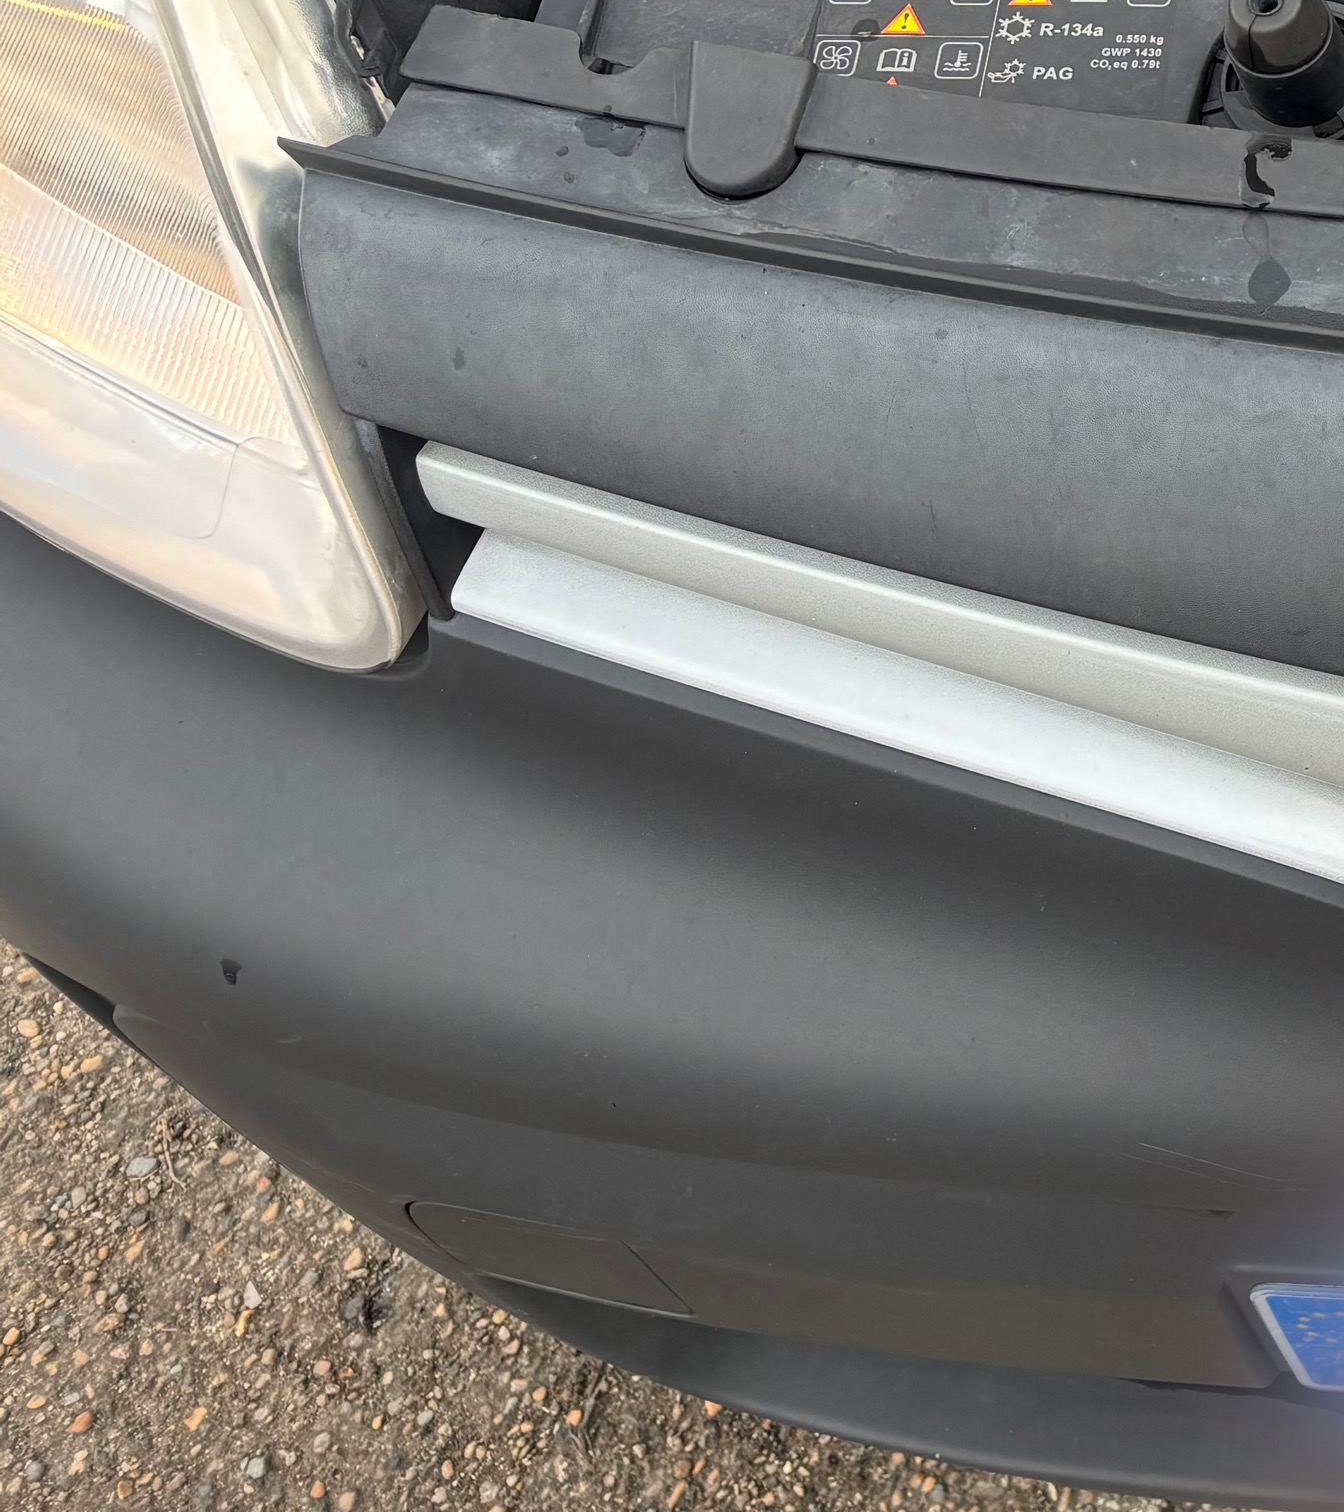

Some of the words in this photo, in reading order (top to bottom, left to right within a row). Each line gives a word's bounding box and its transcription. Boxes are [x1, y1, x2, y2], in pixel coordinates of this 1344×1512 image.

[1039, 22, 1104, 38] R-134a
[1115, 34, 1147, 44] 0.550
[1150, 34, 1164, 46] kg
[1101, 47, 1131, 57] GWP
[1134, 48, 1162, 57] 1430
[1131, 59, 1161, 69] 0.79t
[1032, 66, 1073, 81] PAG
